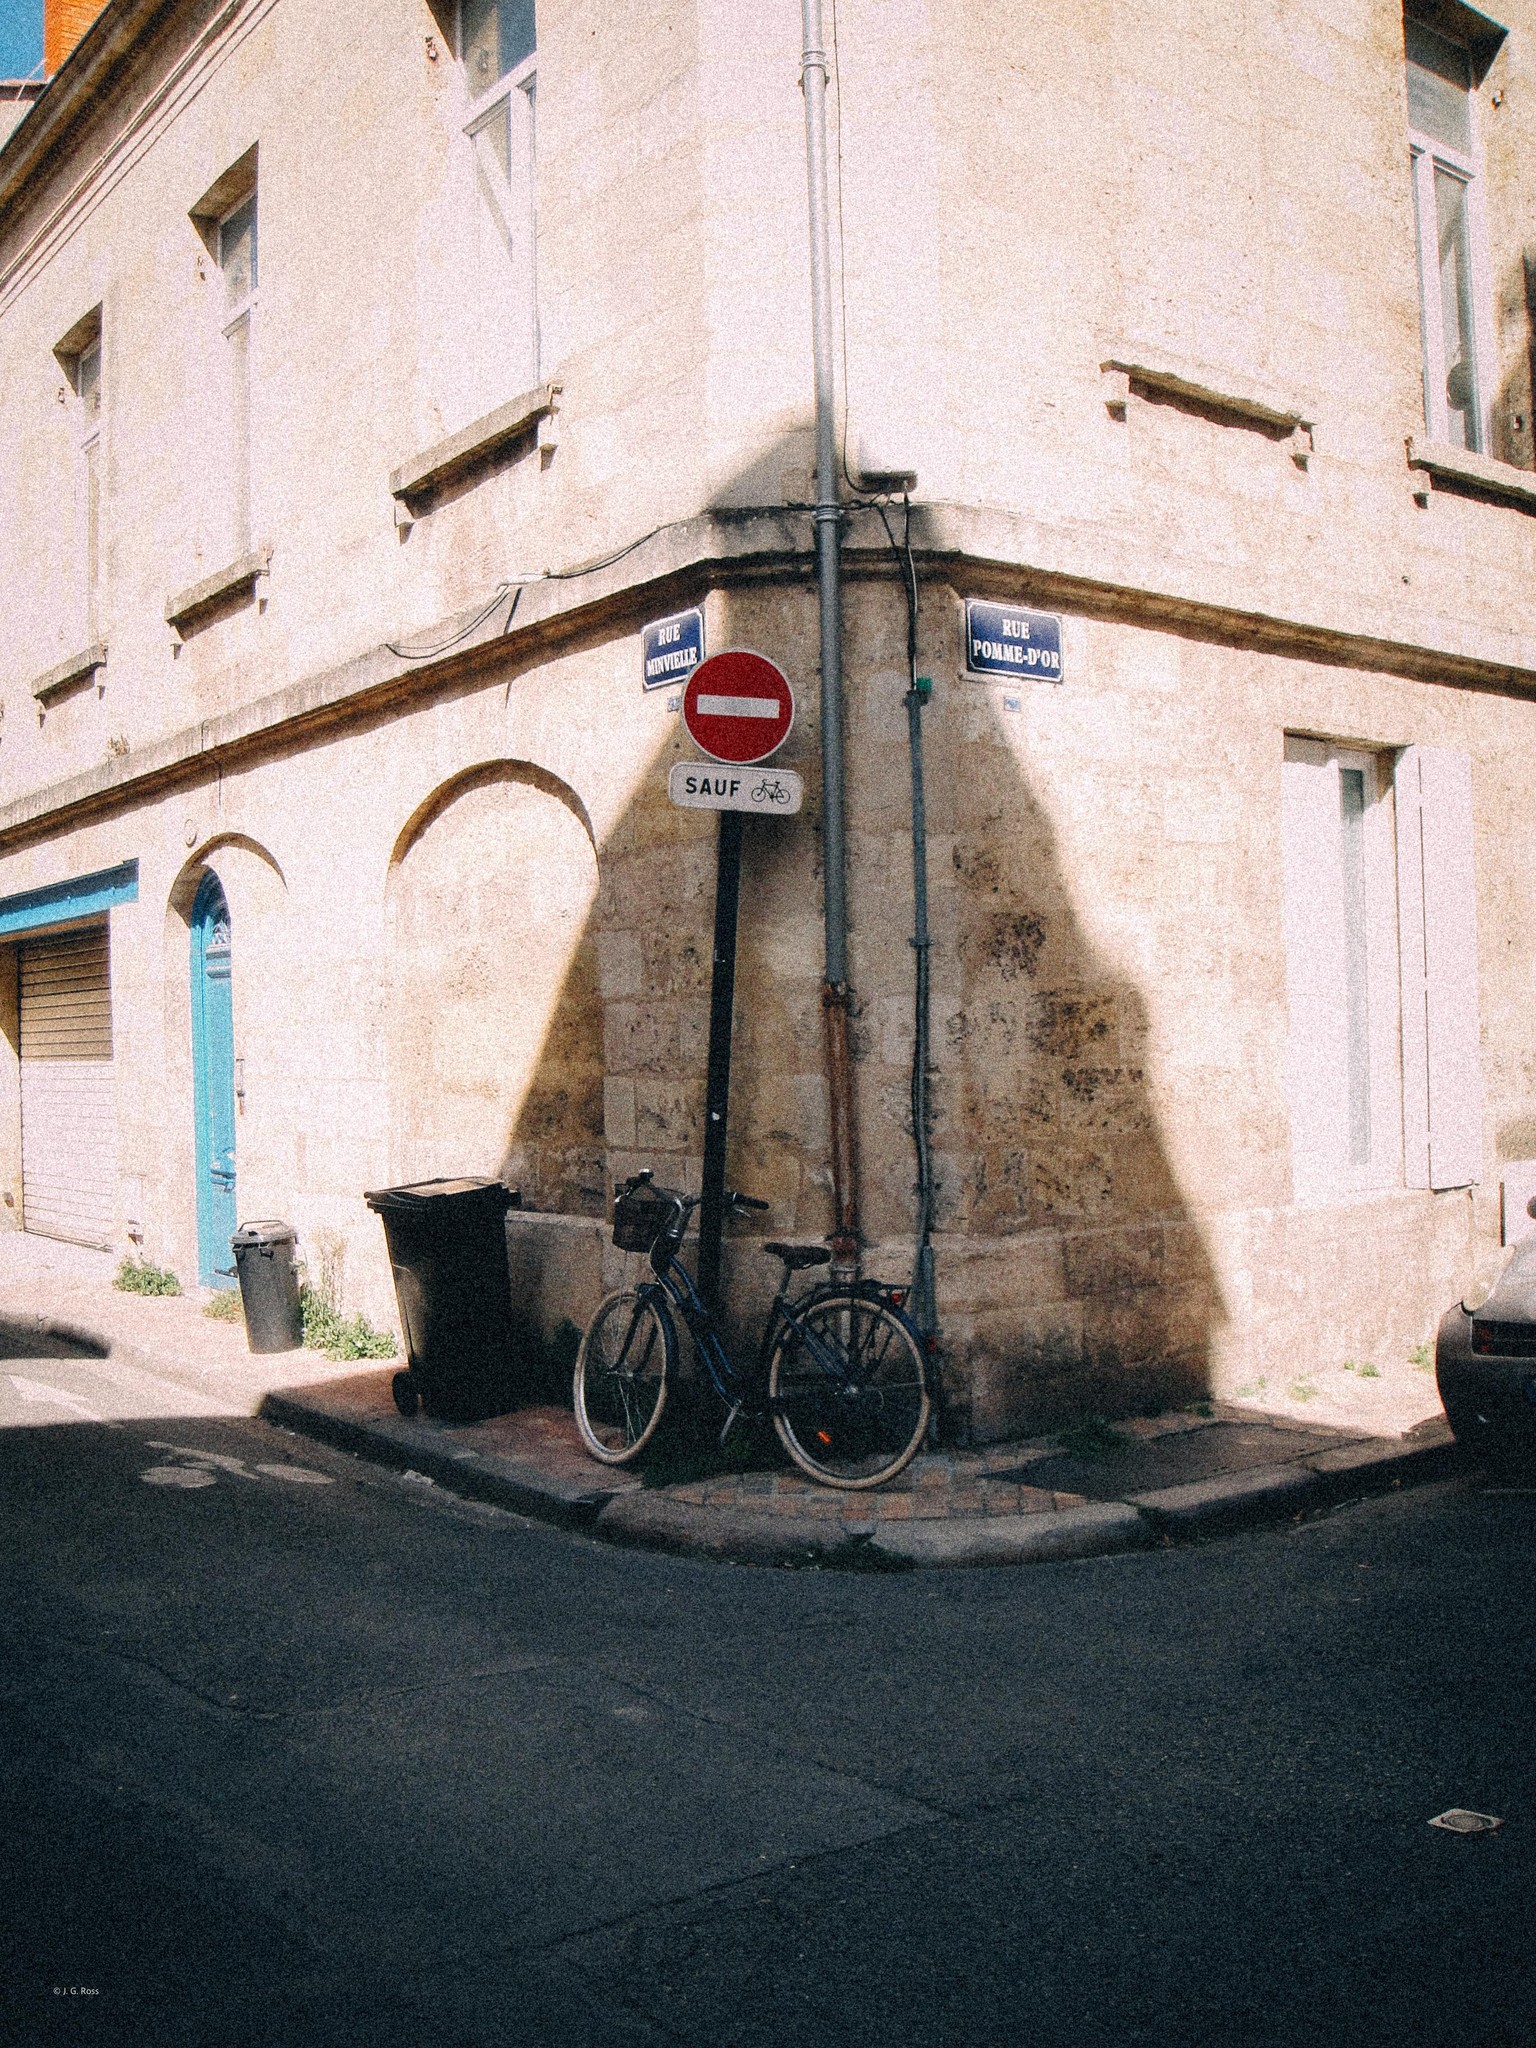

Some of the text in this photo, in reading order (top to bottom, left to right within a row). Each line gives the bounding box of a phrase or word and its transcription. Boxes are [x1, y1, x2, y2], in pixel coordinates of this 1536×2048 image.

[658, 623, 681, 647] RUE
[1002, 618, 1030, 640] RUE
[646, 646, 698, 677] MINVIELLE
[972, 639, 1060, 669] POMME-D'OR
[685, 776, 741, 798] SAUF
